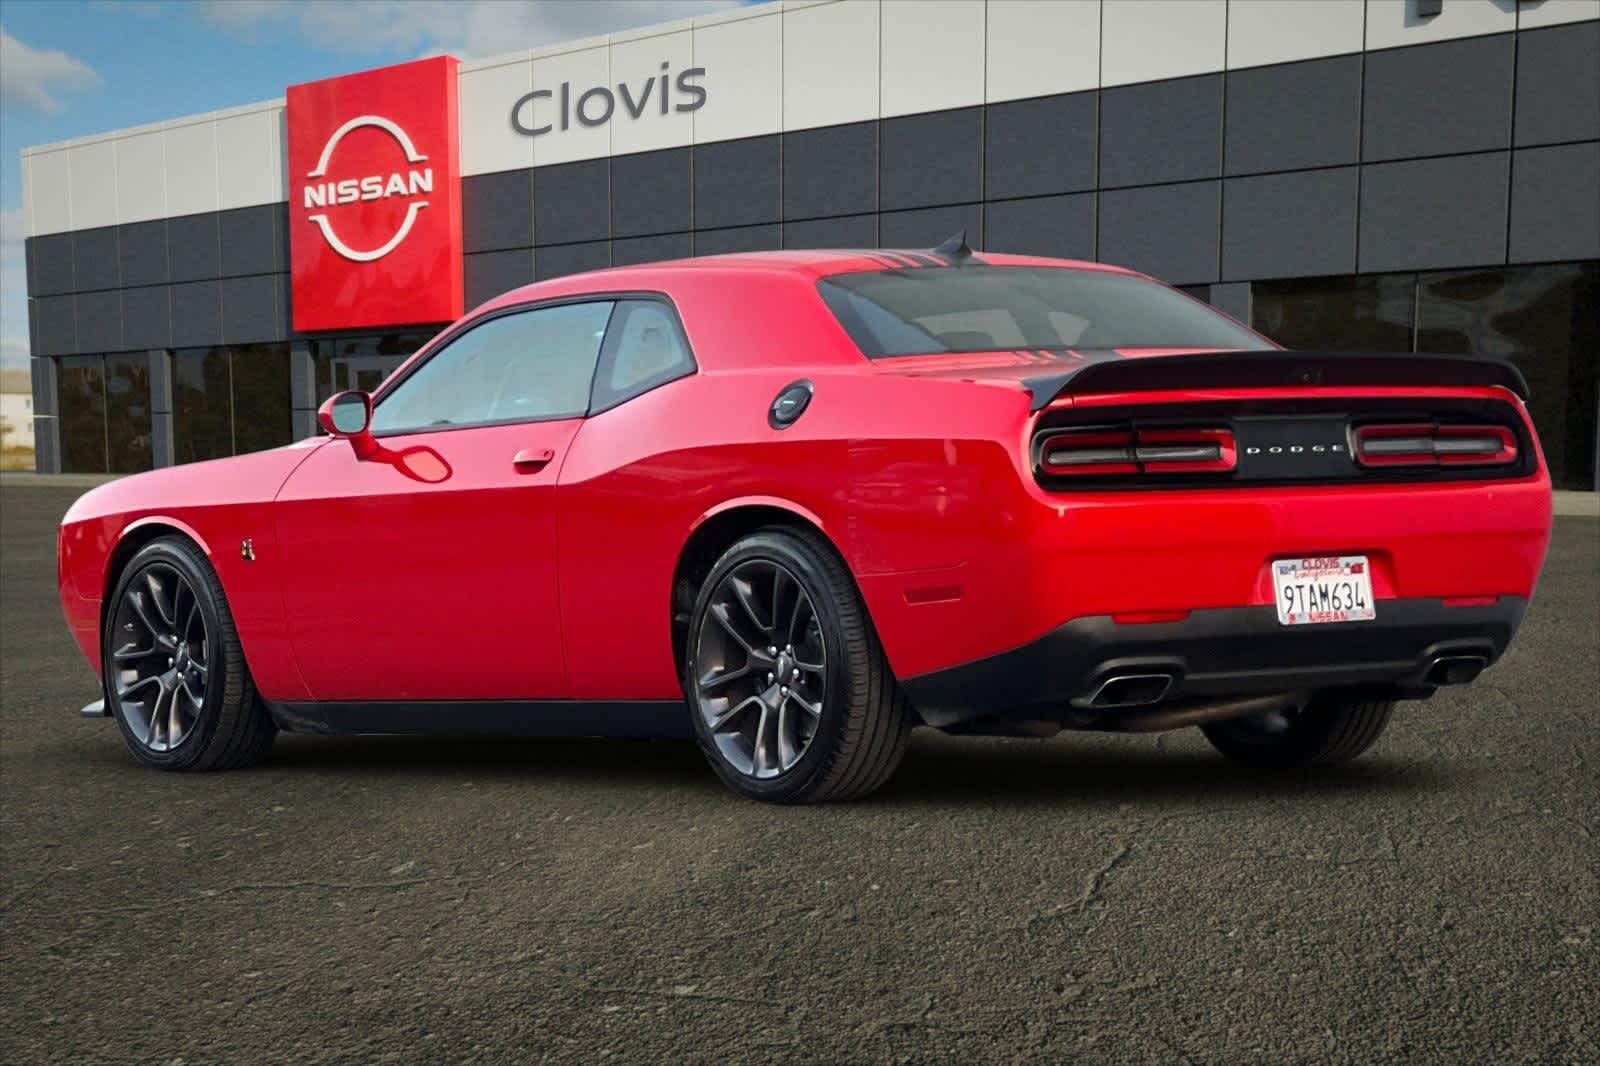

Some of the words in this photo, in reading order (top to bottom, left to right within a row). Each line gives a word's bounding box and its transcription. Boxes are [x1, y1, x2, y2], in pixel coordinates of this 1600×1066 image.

[511, 61, 707, 136] Clovis
[304, 168, 433, 208] NISSAN
[1246, 444, 1344, 454] DODGE
[1284, 582, 1365, 613] 9TAM634
